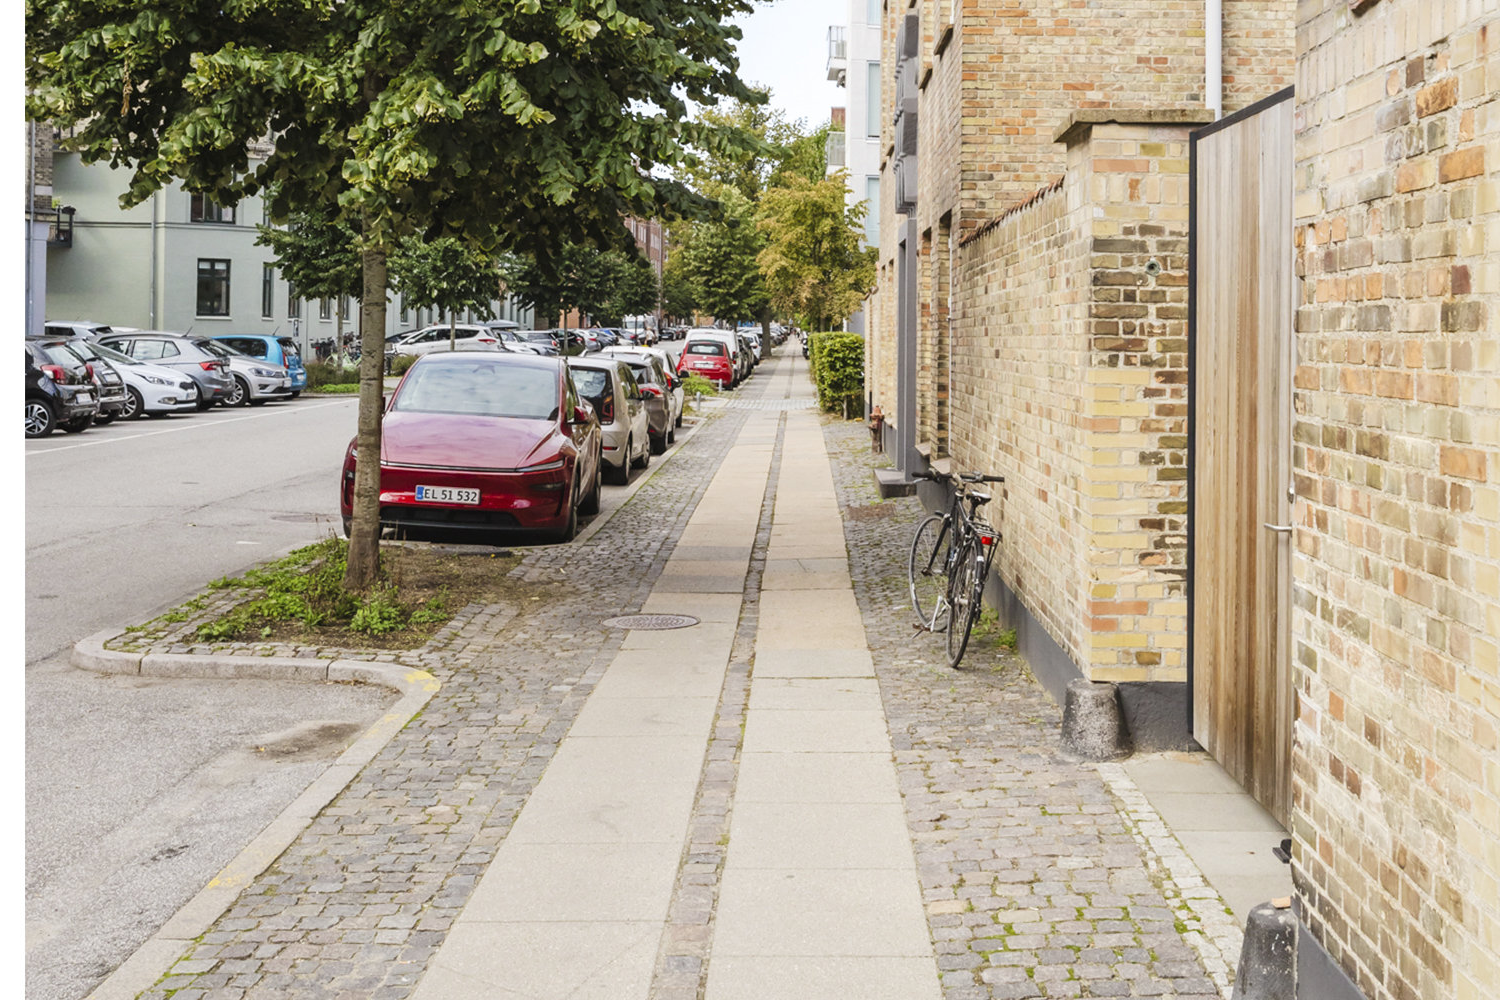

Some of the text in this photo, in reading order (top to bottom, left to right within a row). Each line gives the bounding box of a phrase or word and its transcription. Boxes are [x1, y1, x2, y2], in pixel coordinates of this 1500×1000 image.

[424, 488, 478, 502] EL 51 532
